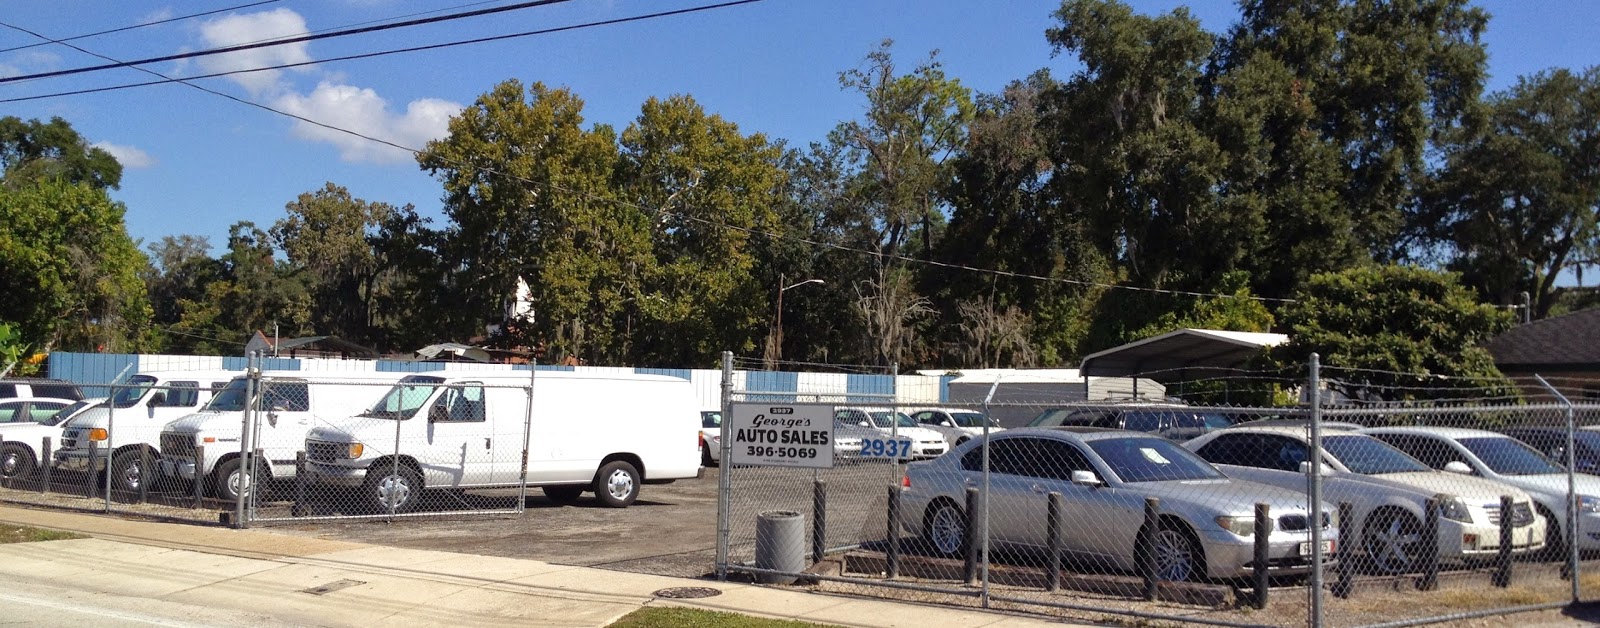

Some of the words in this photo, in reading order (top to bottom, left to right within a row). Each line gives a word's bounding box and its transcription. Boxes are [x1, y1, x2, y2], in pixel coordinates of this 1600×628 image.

[752, 414, 811, 428] George's
[736, 429, 778, 443] AUTO
[781, 430, 829, 445] SALES
[860, 439, 911, 457] 2937
